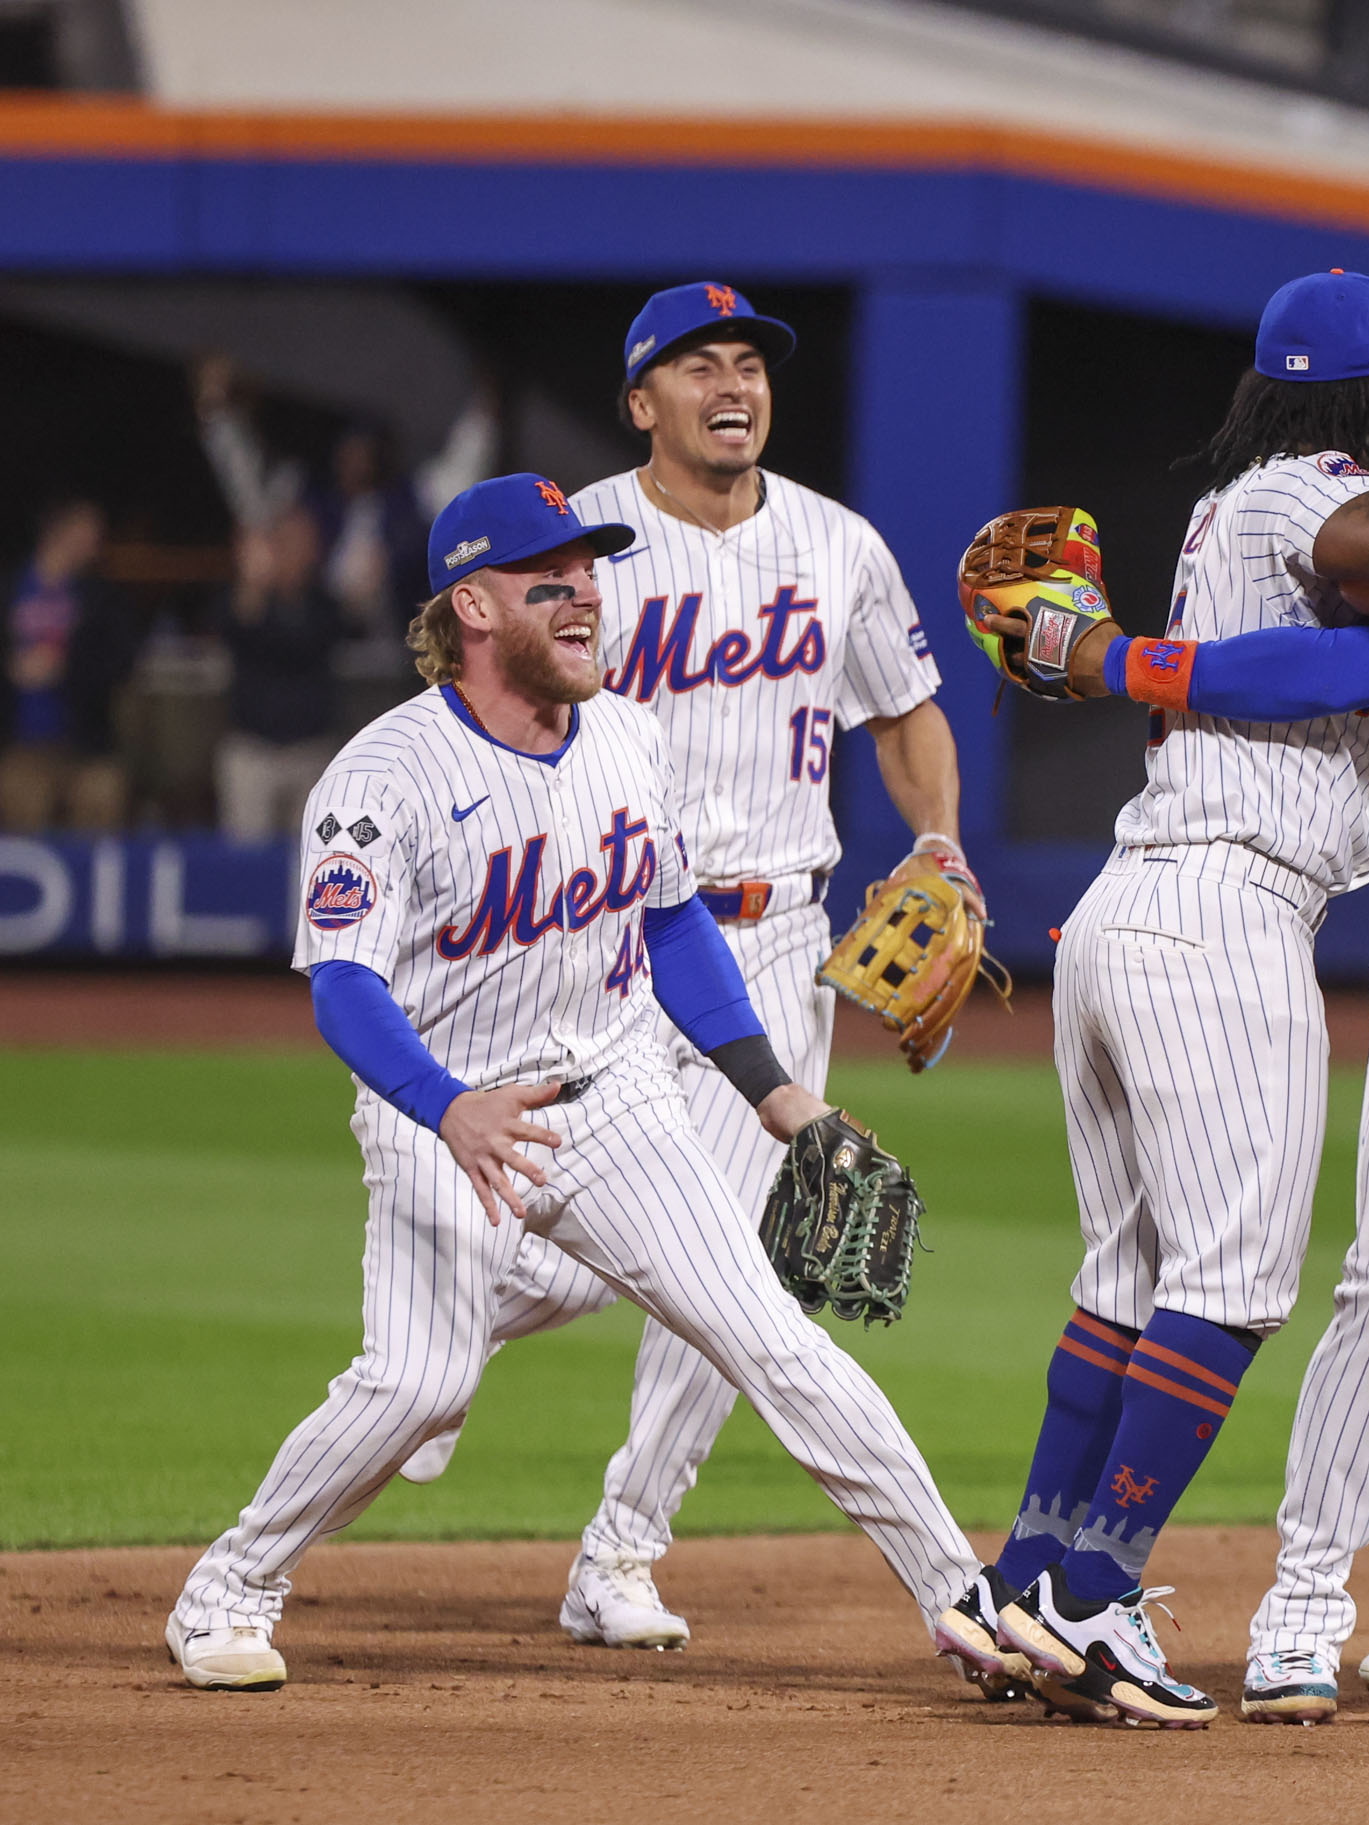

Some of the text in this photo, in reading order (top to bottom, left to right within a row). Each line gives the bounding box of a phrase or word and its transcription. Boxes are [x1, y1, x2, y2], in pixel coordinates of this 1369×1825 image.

[534, 480, 569, 516] NY
[444, 537, 489, 569] POSTSEASON
[602, 584, 826, 703] Mets
[789, 705, 832, 785] 15
[313, 882, 364, 909] Mets
[435, 806, 657, 962] Mets
